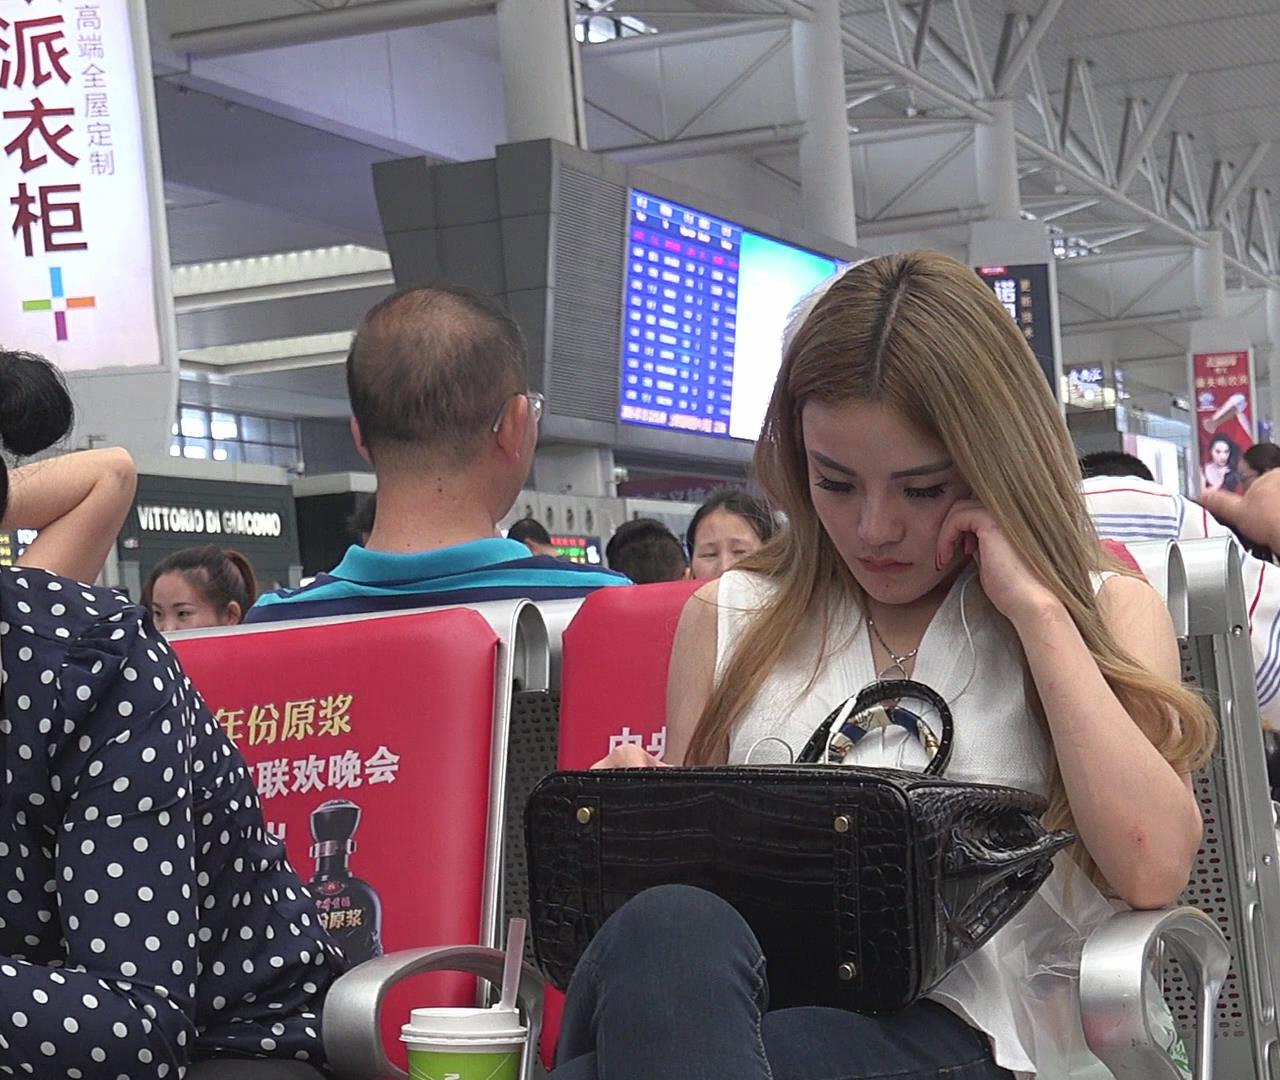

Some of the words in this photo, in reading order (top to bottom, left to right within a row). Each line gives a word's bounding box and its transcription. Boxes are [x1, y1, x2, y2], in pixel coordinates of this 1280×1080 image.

[75, 5, 115, 176] 高端全屋定制
[137, 506, 204, 533] VITTORIO
[205, 509, 221, 534] DI
[222, 509, 281, 537] GIACOMO
[216, 694, 352, 746] 年份原浆
[248, 746, 401, 799] 联欢晚会
